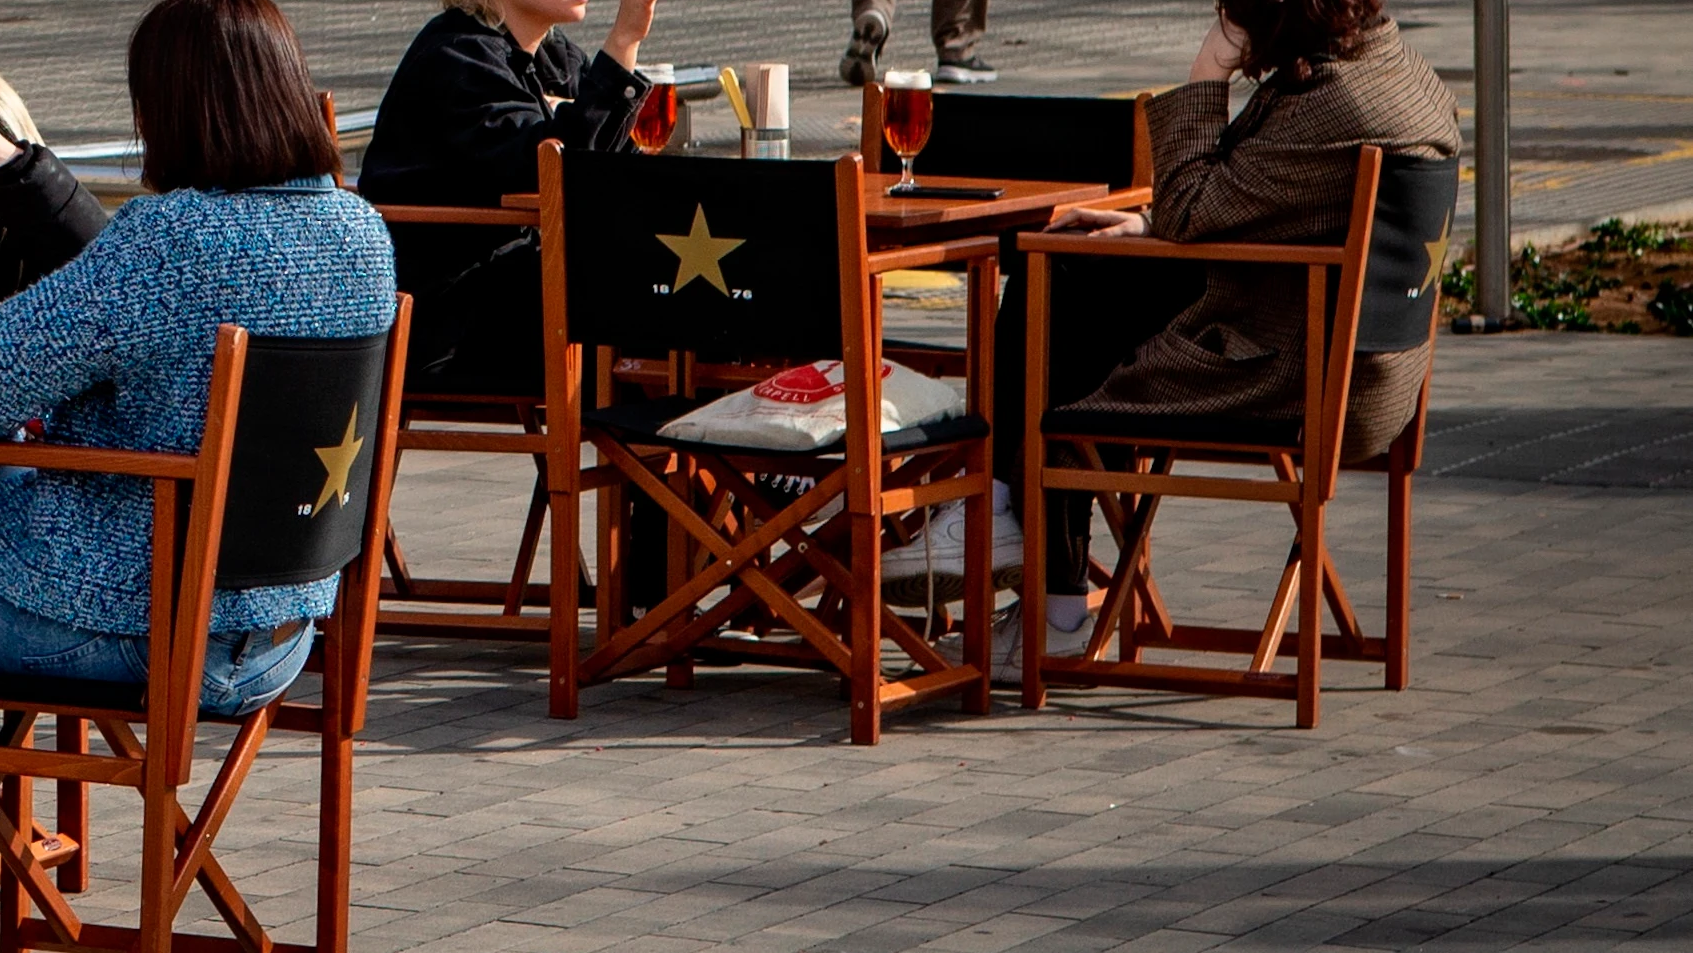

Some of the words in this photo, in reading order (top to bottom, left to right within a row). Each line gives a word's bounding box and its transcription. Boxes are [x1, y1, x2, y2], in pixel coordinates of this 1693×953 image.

[652, 283, 670, 295] 18
[731, 288, 753, 301] 76
[297, 503, 313, 516] 18
